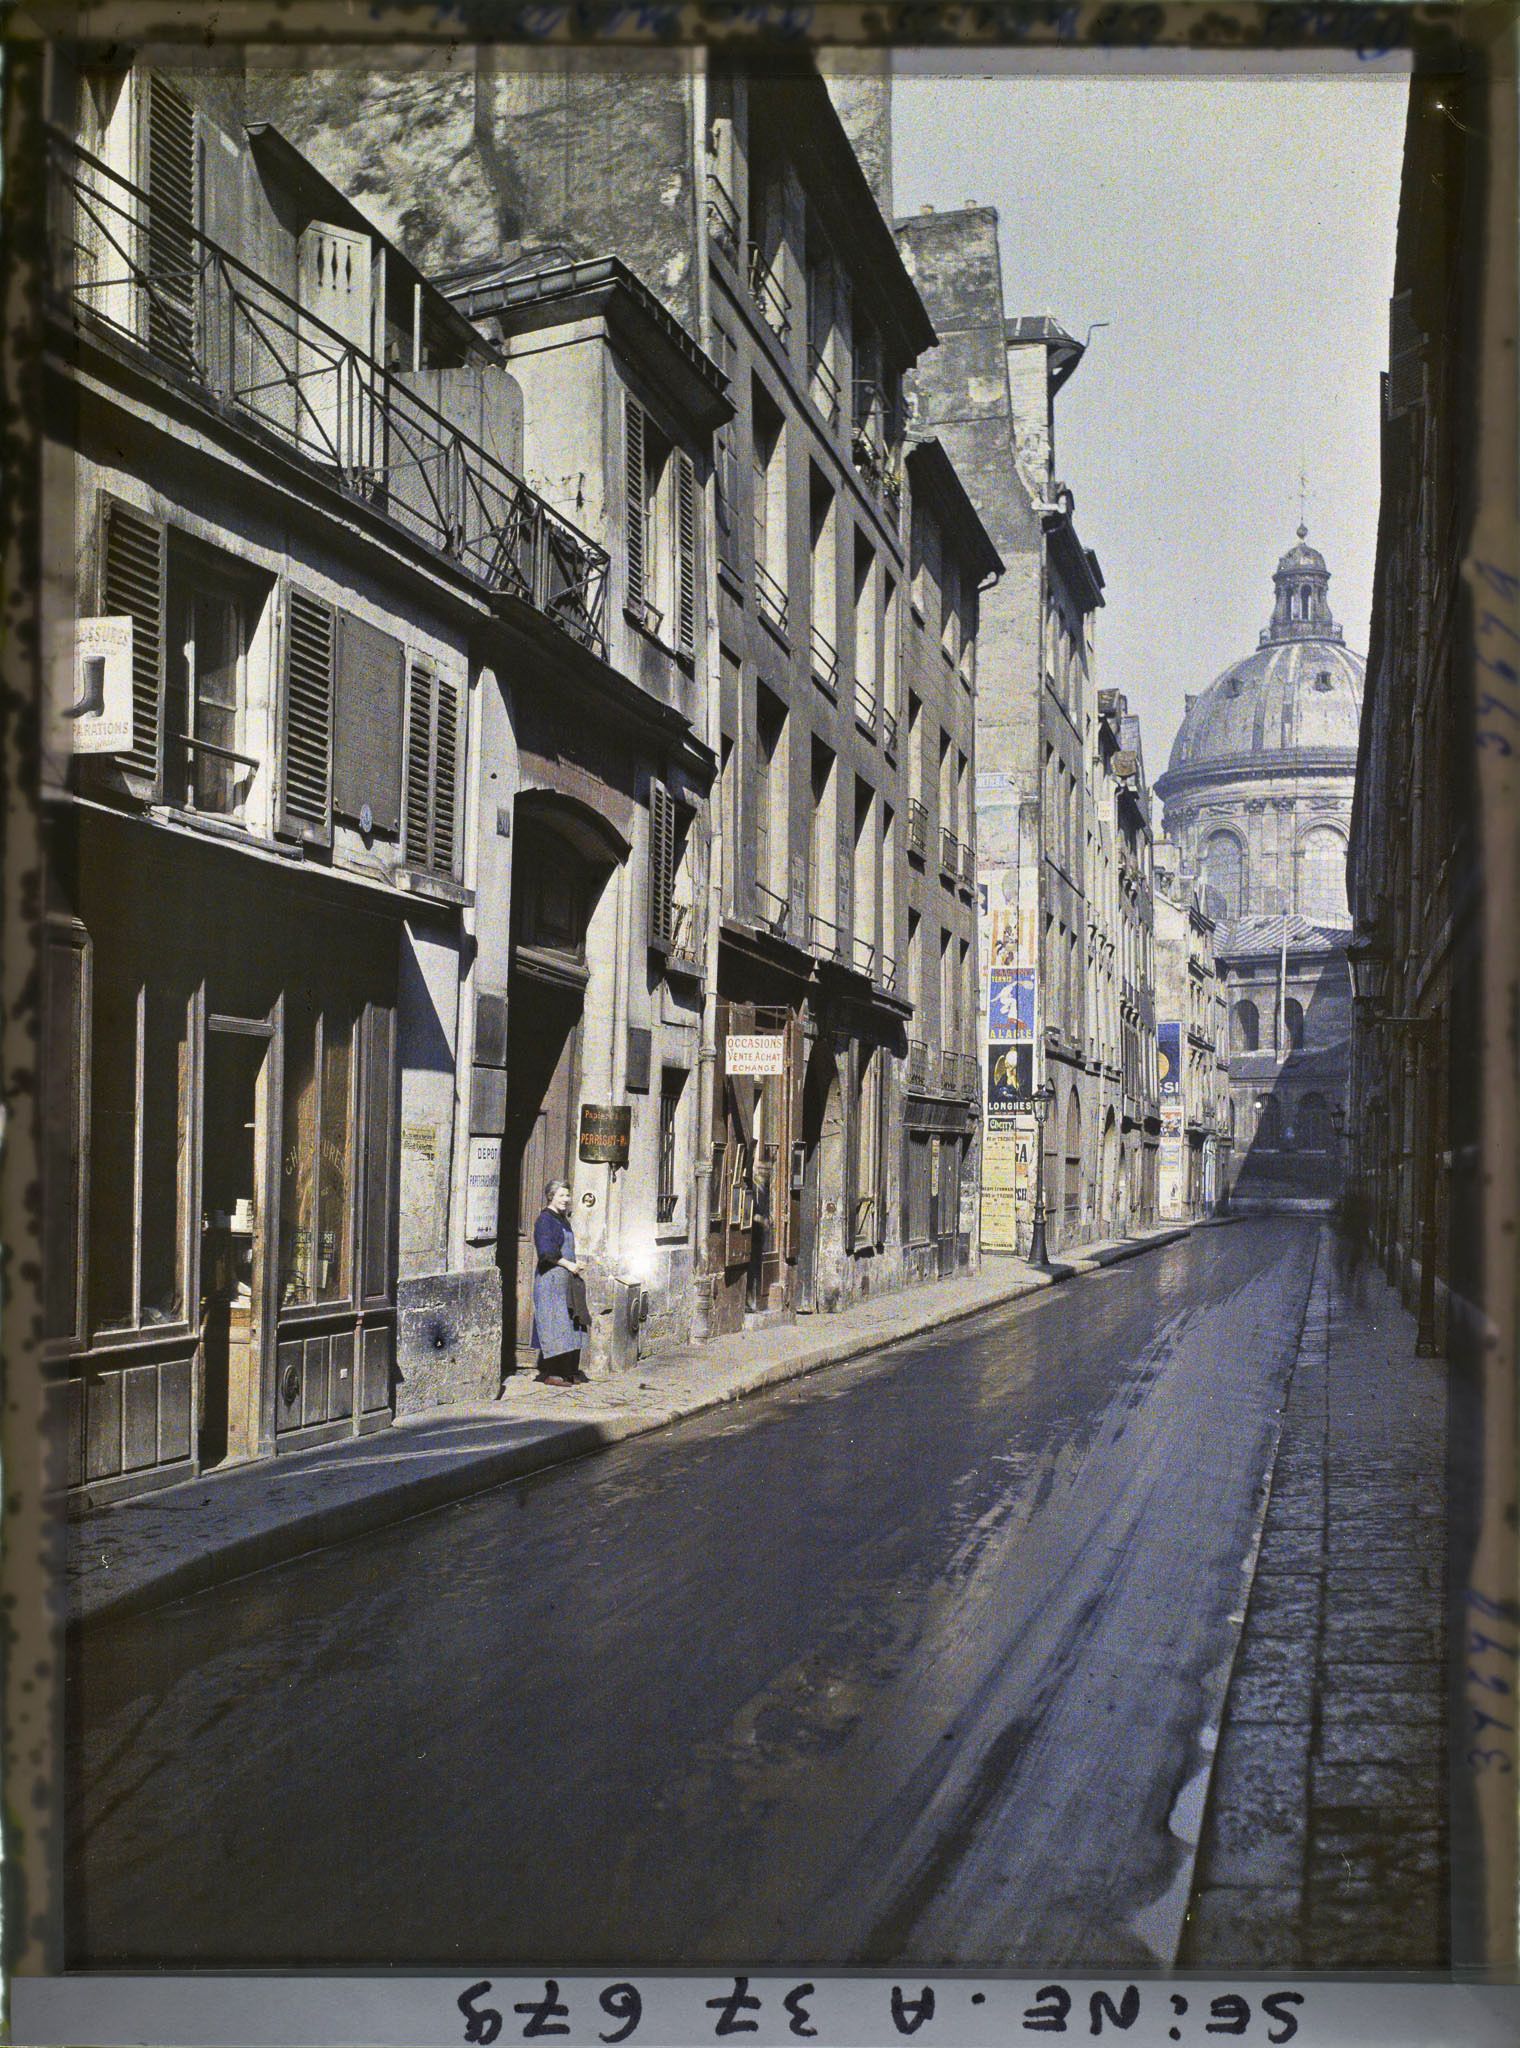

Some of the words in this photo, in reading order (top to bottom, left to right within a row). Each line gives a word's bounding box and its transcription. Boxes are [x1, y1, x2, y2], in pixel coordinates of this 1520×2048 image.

[727, 1038, 783, 1049] OCCASIONS
[727, 1050, 753, 1061] VENTE
[755, 1052, 781, 1062] ACHAT
[732, 1064, 776, 1072] ECHANGE
[705, 1978, 818, 2037] 37
[890, 1986, 935, 2035] A
